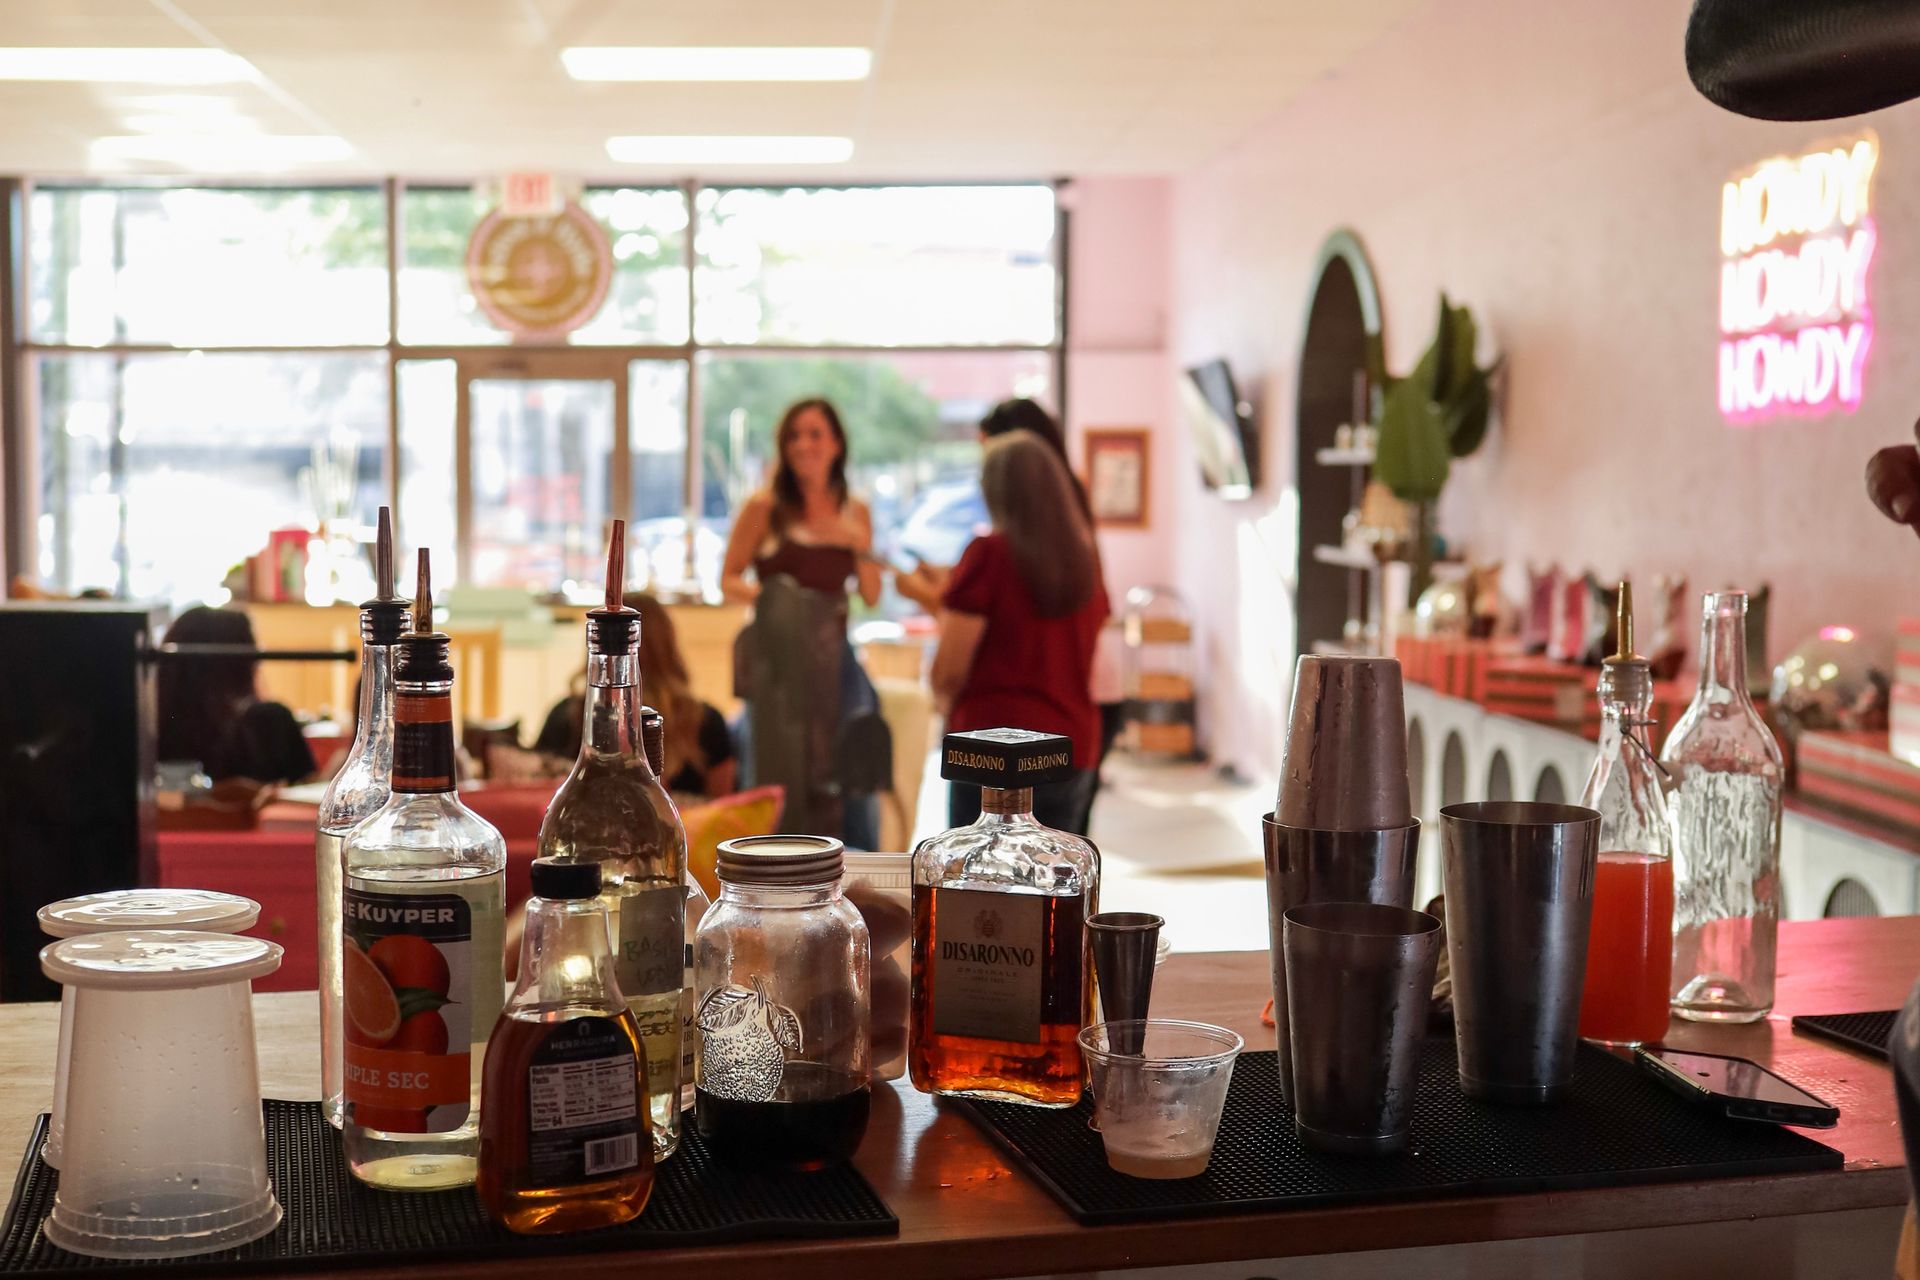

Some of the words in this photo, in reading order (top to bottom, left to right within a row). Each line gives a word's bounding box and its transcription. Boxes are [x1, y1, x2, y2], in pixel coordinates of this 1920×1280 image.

[1720, 139, 1874, 257] HOWDY
[1719, 229, 1870, 333] HOWDY
[1718, 322, 1868, 413] HOWDY
[948, 751, 1005, 771] DISARONNO
[1018, 753, 1069, 772] DISARONNO
[942, 941, 1034, 967] DISARONNO
[344, 1063, 380, 1086] IPLE
[387, 1071, 429, 1089] SEC
